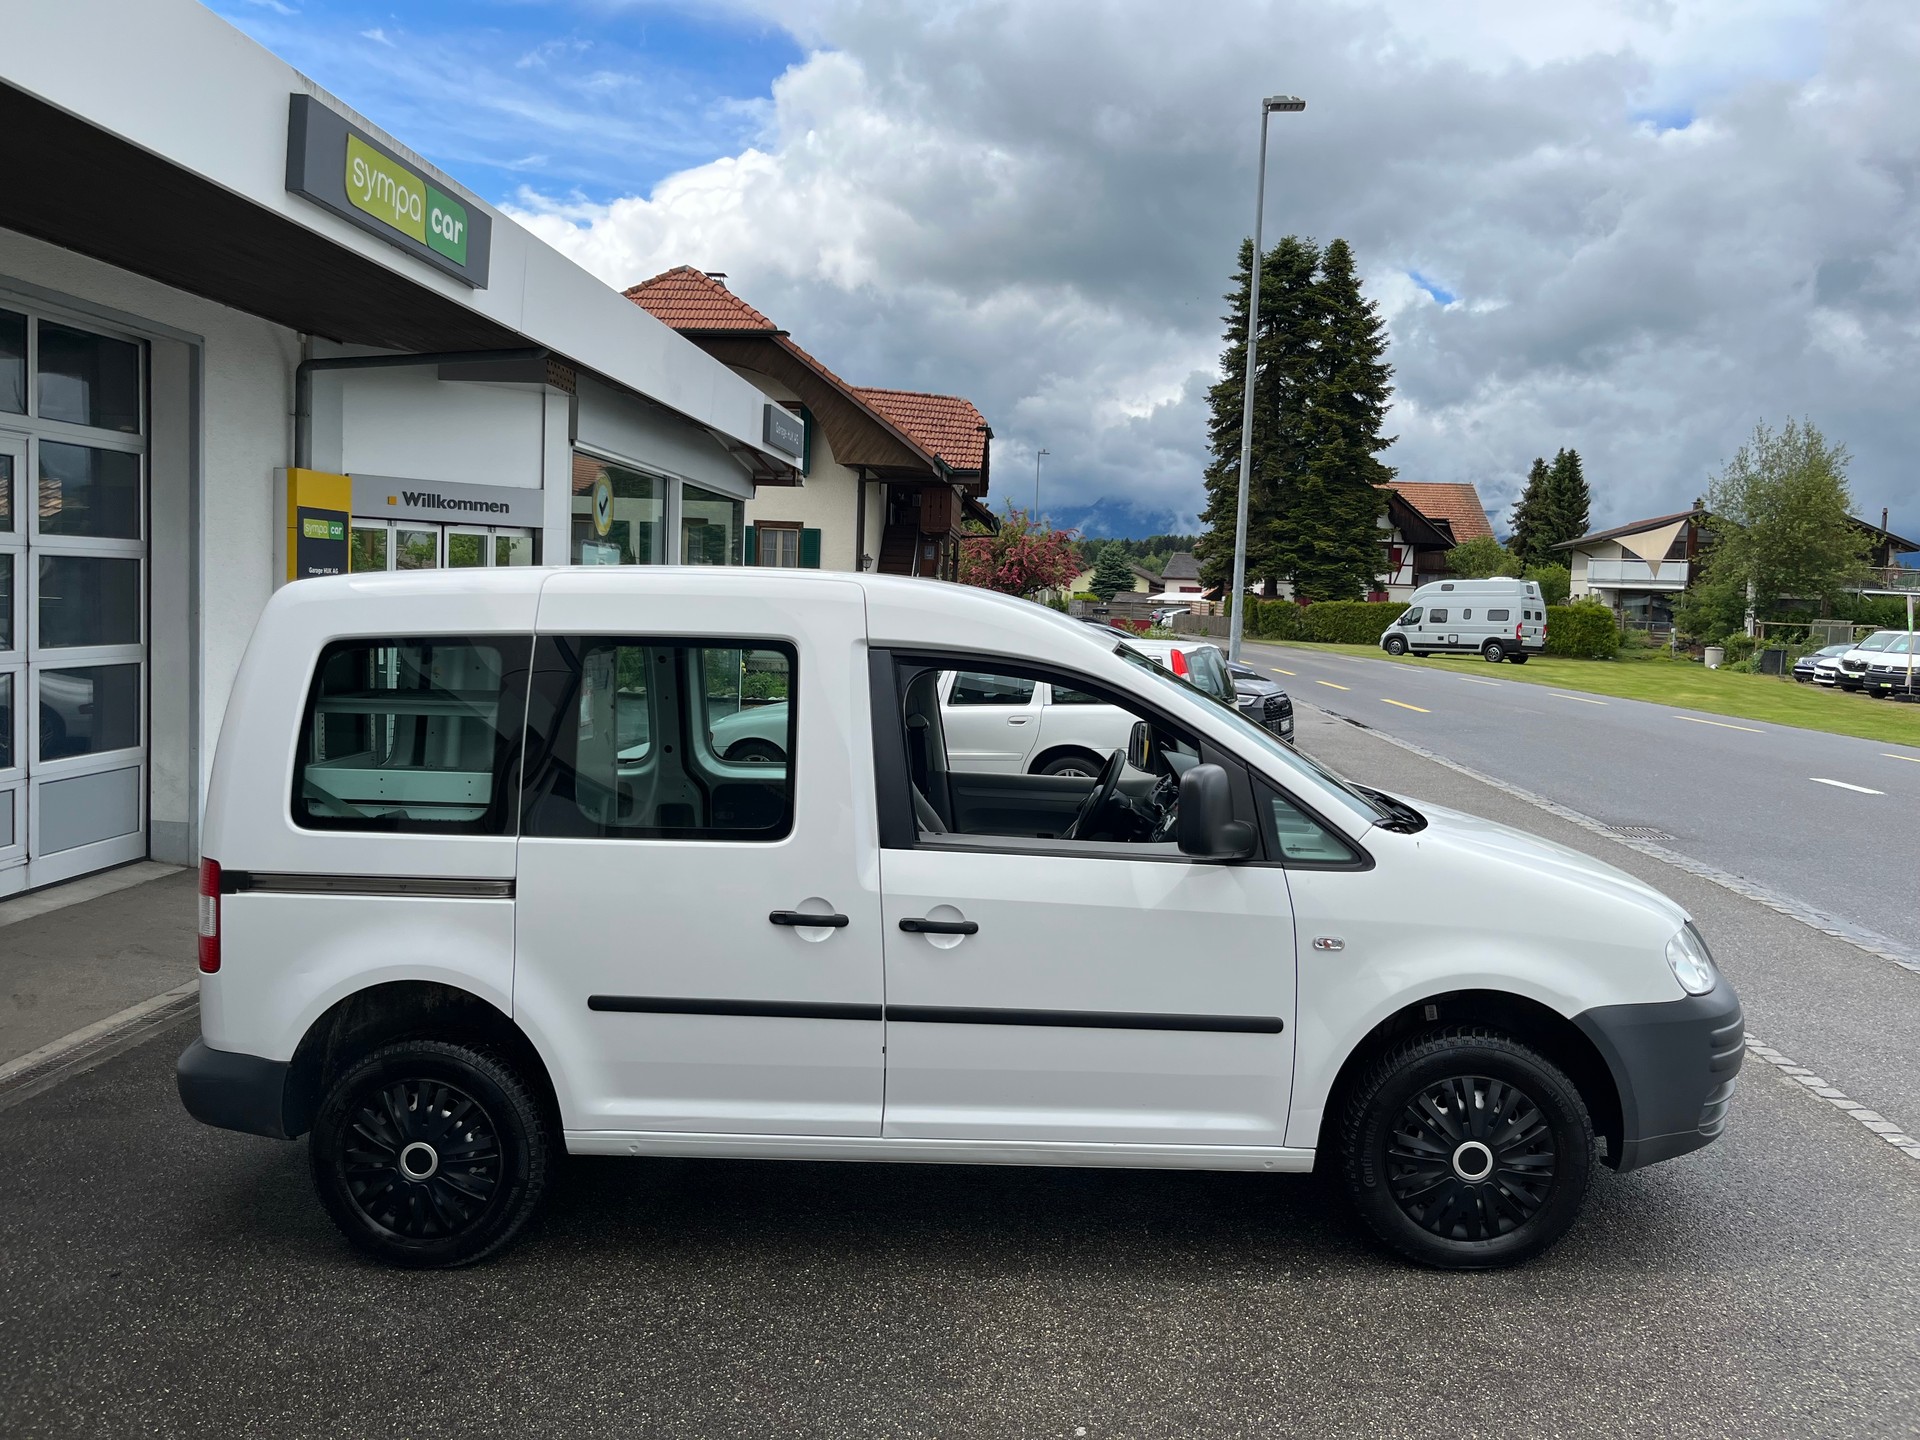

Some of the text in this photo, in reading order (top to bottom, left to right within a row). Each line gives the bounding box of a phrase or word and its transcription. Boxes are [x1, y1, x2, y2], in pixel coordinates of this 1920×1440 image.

[353, 157, 464, 244] sympa car
[402, 491, 510, 514] Willkommen
[304, 523, 342, 536] sympa car
[308, 566, 323, 575] Garage
